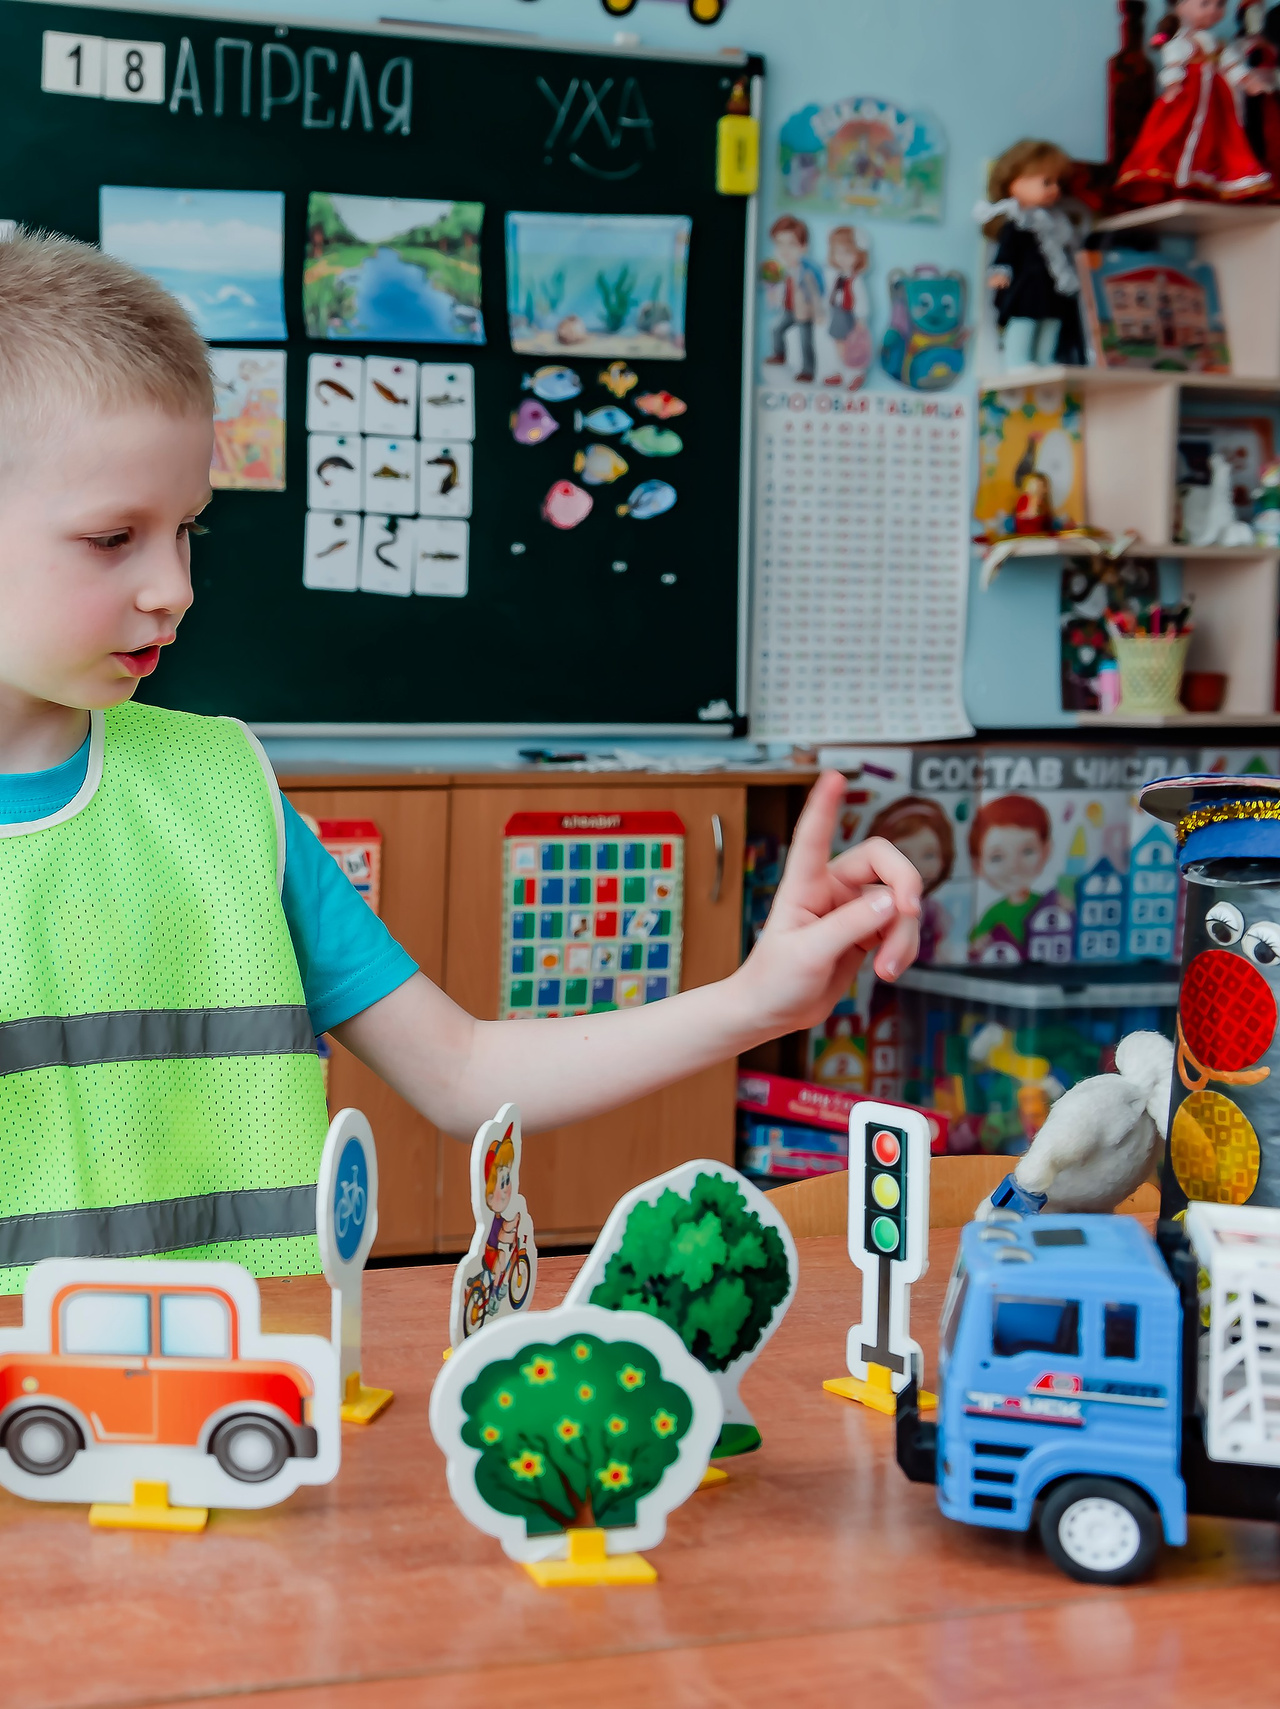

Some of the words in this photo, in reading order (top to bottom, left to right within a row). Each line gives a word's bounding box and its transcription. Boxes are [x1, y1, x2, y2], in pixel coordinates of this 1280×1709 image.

[169, 37, 413, 135] АПРЕЛЯ
[536, 76, 657, 150] УХА
[759, 392, 869, 413] СЛОГОВАЯ
[877, 396, 964, 419] ТАБЛИЦА
[920, 757, 1064, 788] СОСТАВ
[1073, 757, 1193, 787] ЧИСЛА
